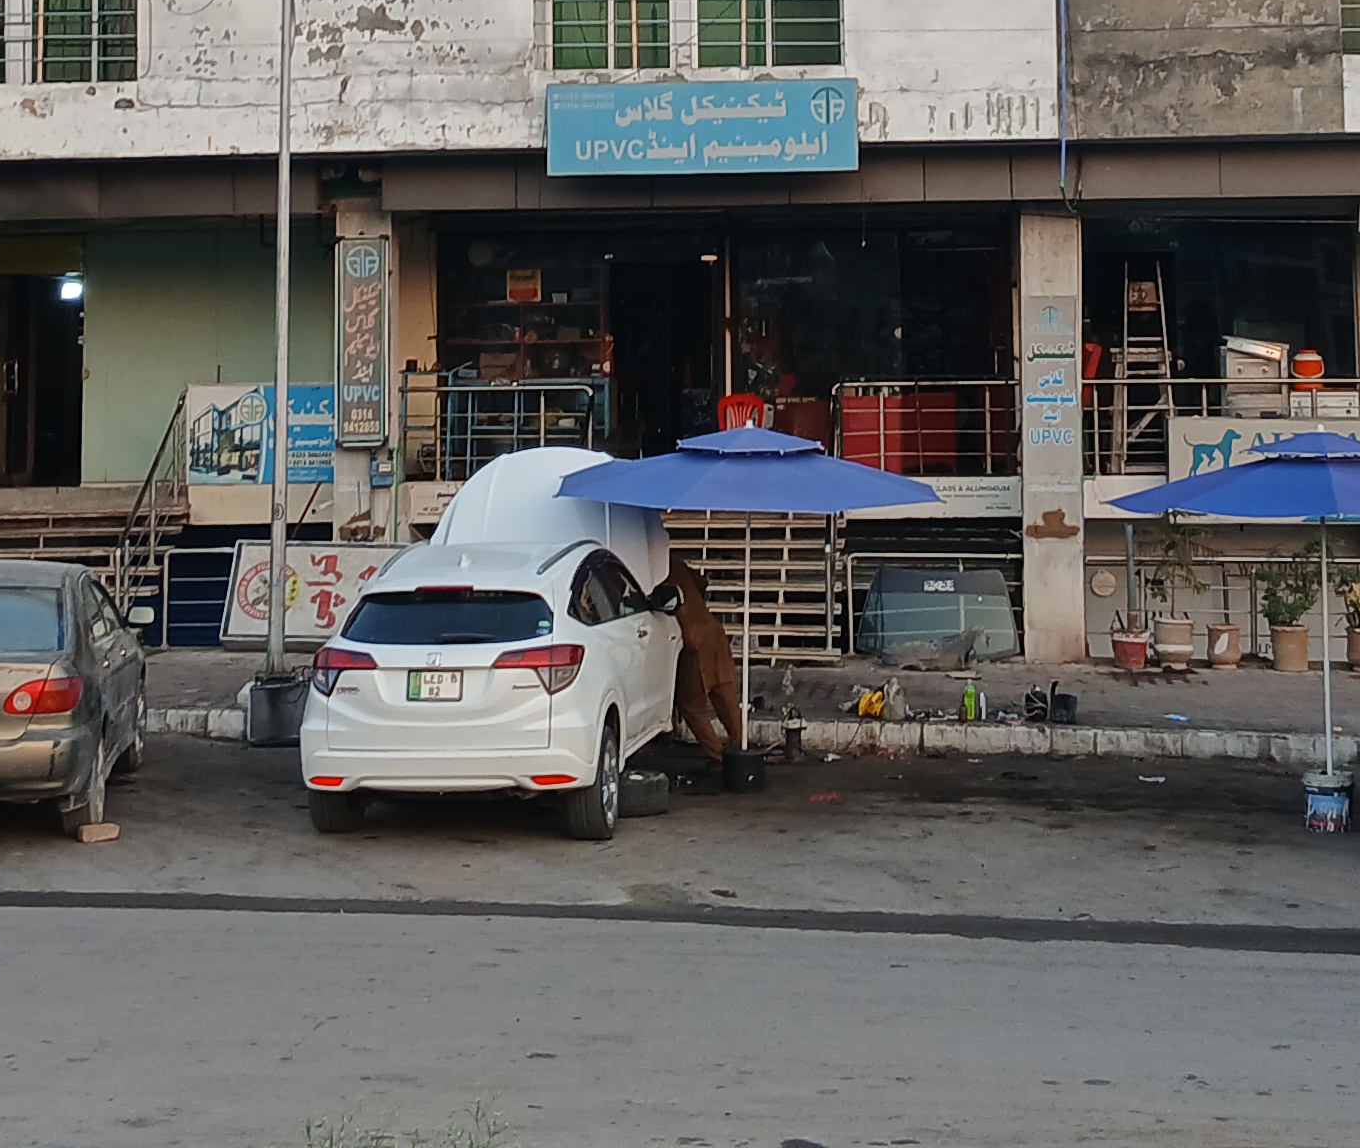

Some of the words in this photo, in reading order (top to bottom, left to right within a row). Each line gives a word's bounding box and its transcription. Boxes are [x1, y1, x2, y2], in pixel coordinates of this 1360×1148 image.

[615, 91, 674, 127] گلاس
[681, 88, 787, 125] ٹیکنیکل
[576, 139, 645, 160] UPVC
[343, 384, 380, 403] UPVC
[1030, 428, 1075, 447] UPVC
